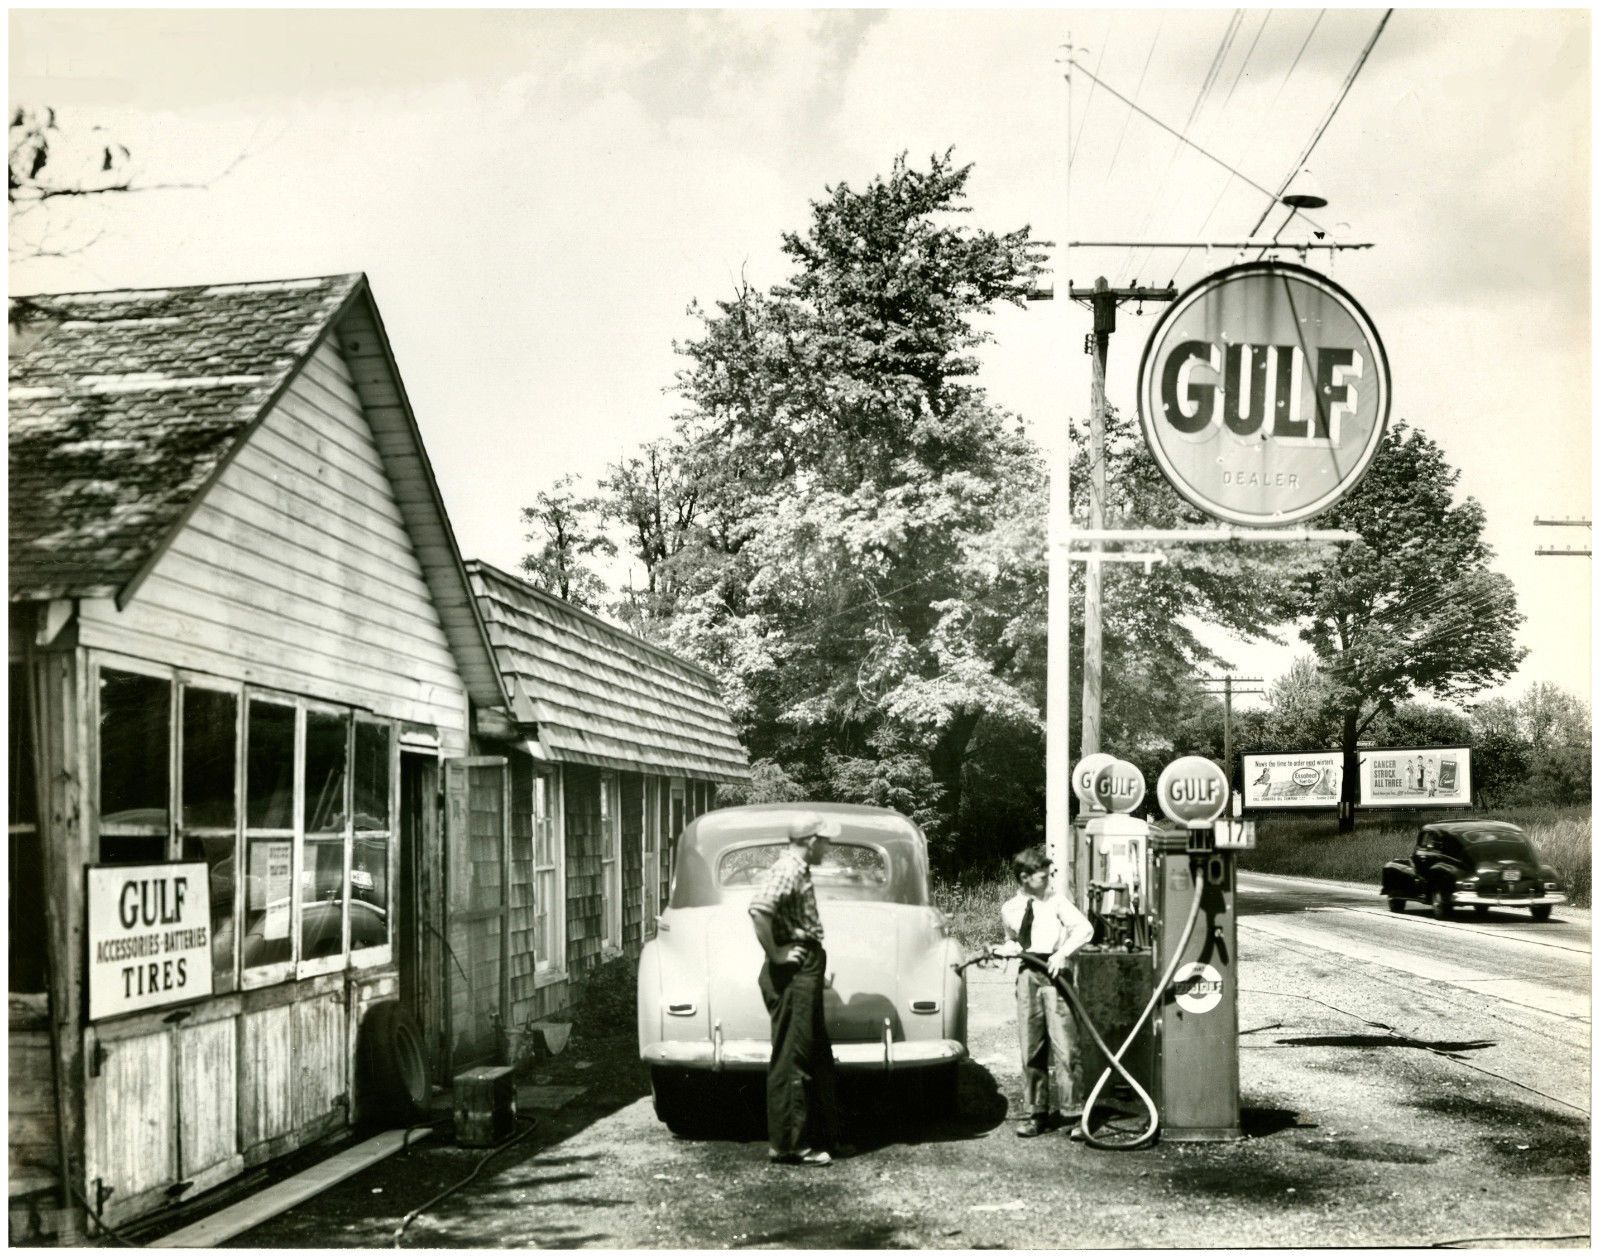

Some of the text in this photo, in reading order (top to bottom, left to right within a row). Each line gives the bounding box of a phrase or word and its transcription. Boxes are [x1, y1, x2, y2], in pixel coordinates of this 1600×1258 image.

[1162, 340, 1362, 447] GULF
[1223, 471, 1299, 488] DEALER
[1374, 760, 1396, 768] CANCER
[1374, 770, 1396, 778] STRUCK
[1100, 777, 1140, 800] GULF
[1171, 779, 1221, 805] GULF
[1375, 779, 1402, 787] ALL THREE
[1227, 820, 1244, 842] 17
[118, 877, 188, 930] GULF
[122, 958, 187, 998] TIRES
